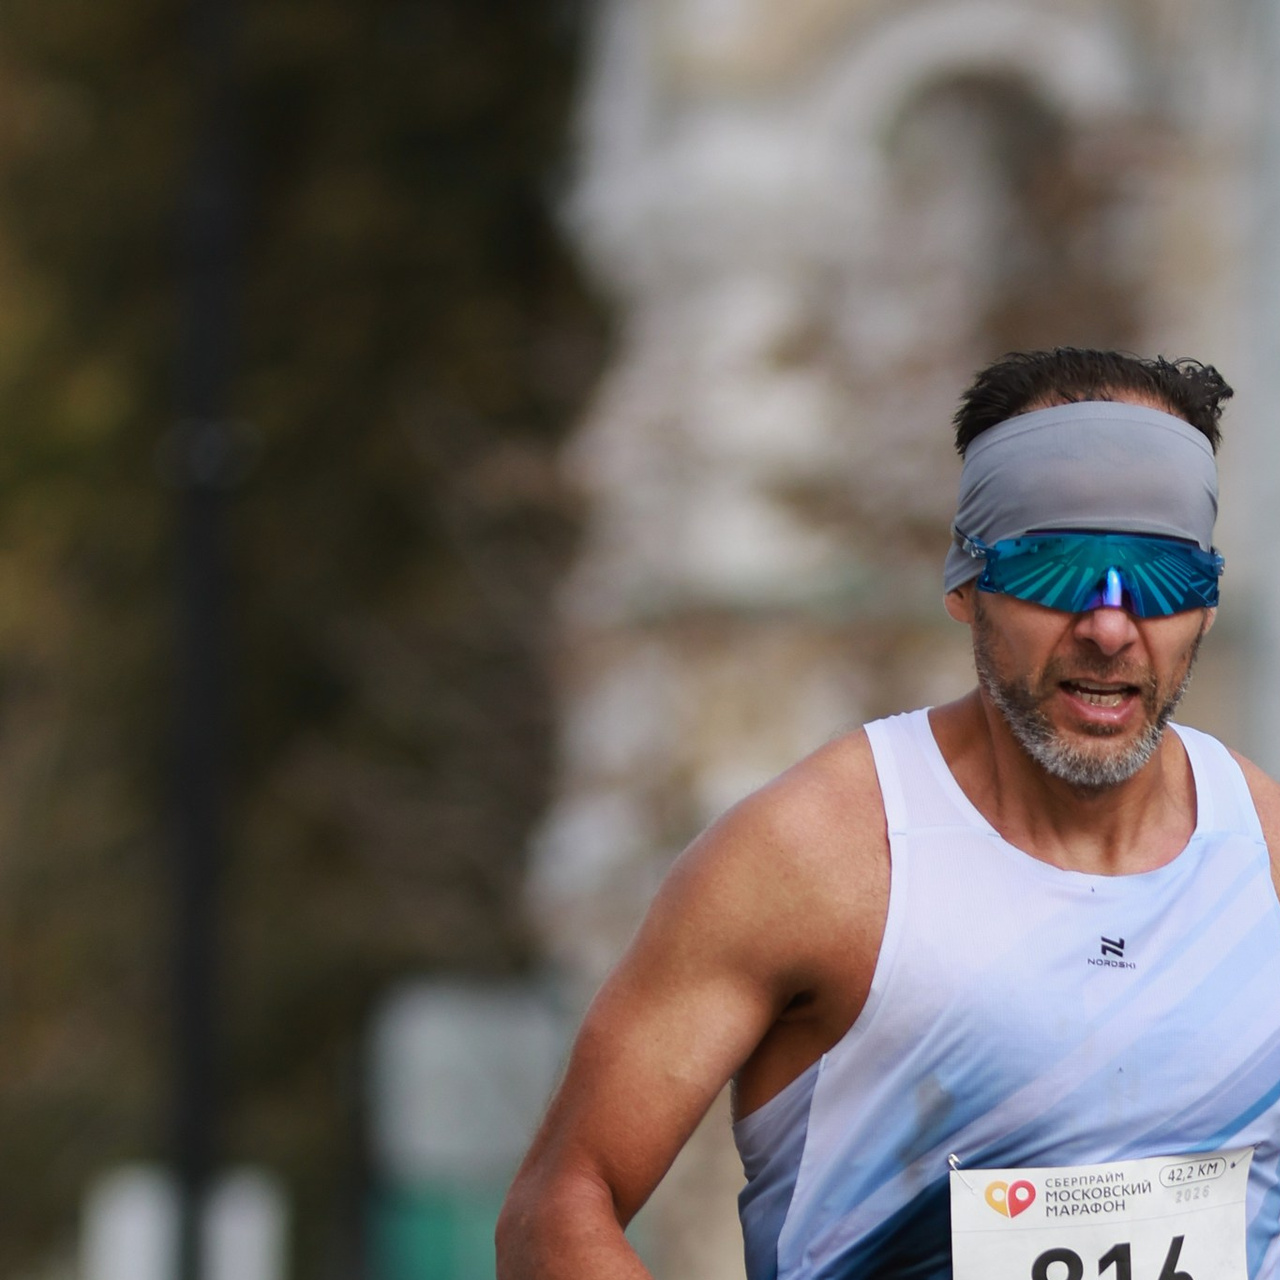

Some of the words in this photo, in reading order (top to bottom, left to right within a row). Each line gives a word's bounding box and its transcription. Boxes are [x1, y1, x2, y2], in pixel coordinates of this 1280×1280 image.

[1087, 958, 1136, 969] NORDSKI
[1045, 1172, 1124, 1188] СБЕРПРАЙМ
[1168, 1165, 1193, 1182] 42,2
[1045, 1179, 1152, 1203] МОСКОВСКИЙ
[1175, 1185, 1210, 1203] 2026
[1046, 1200, 1125, 1217] МАРАФОН
